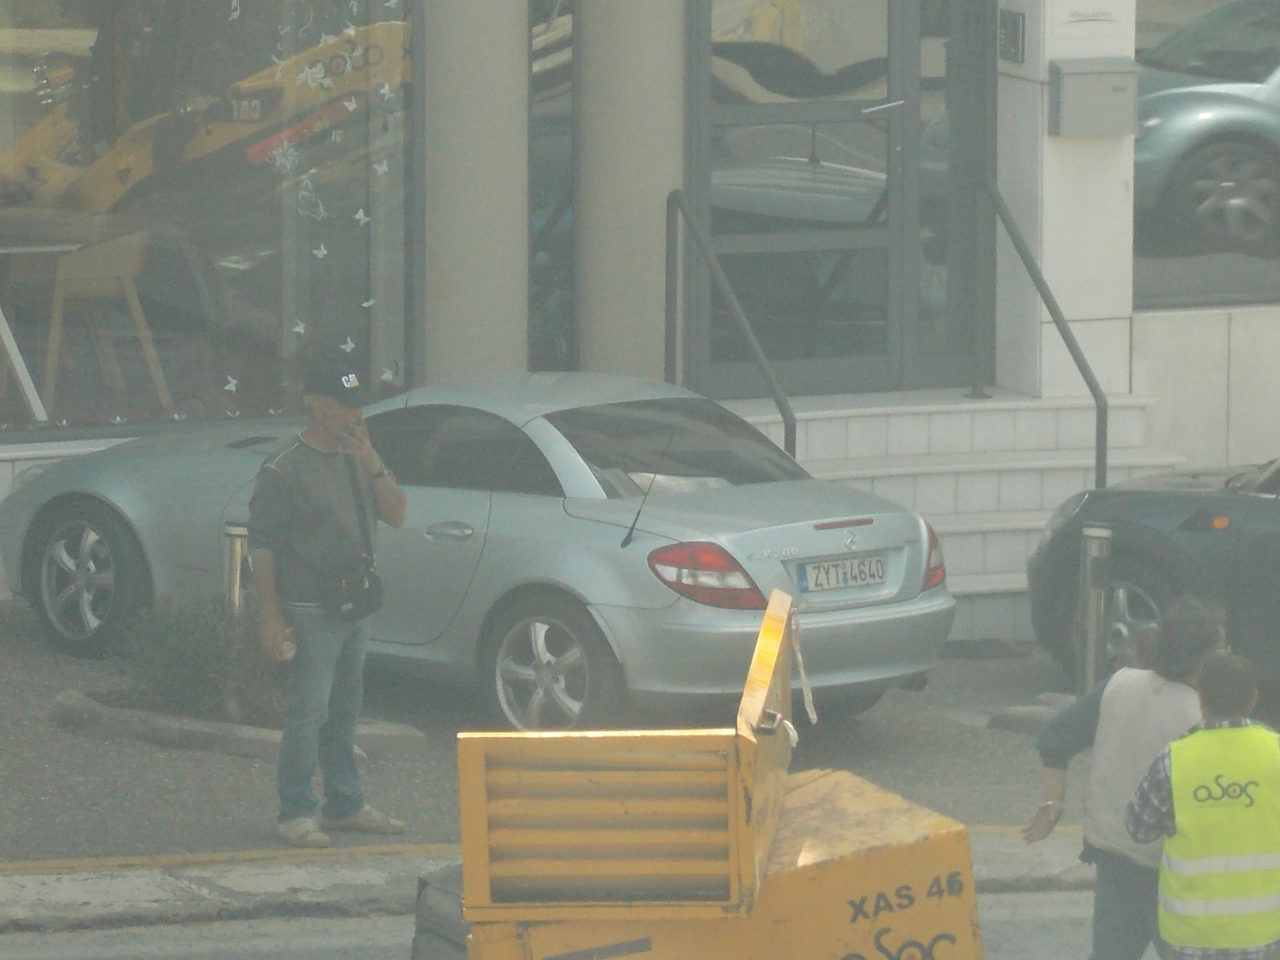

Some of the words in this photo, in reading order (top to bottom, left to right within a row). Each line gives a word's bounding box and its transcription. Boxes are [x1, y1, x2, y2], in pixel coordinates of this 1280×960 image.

[850, 558, 884, 583] 4640
[847, 884, 915, 923] XAS
[926, 871, 964, 900] 46
